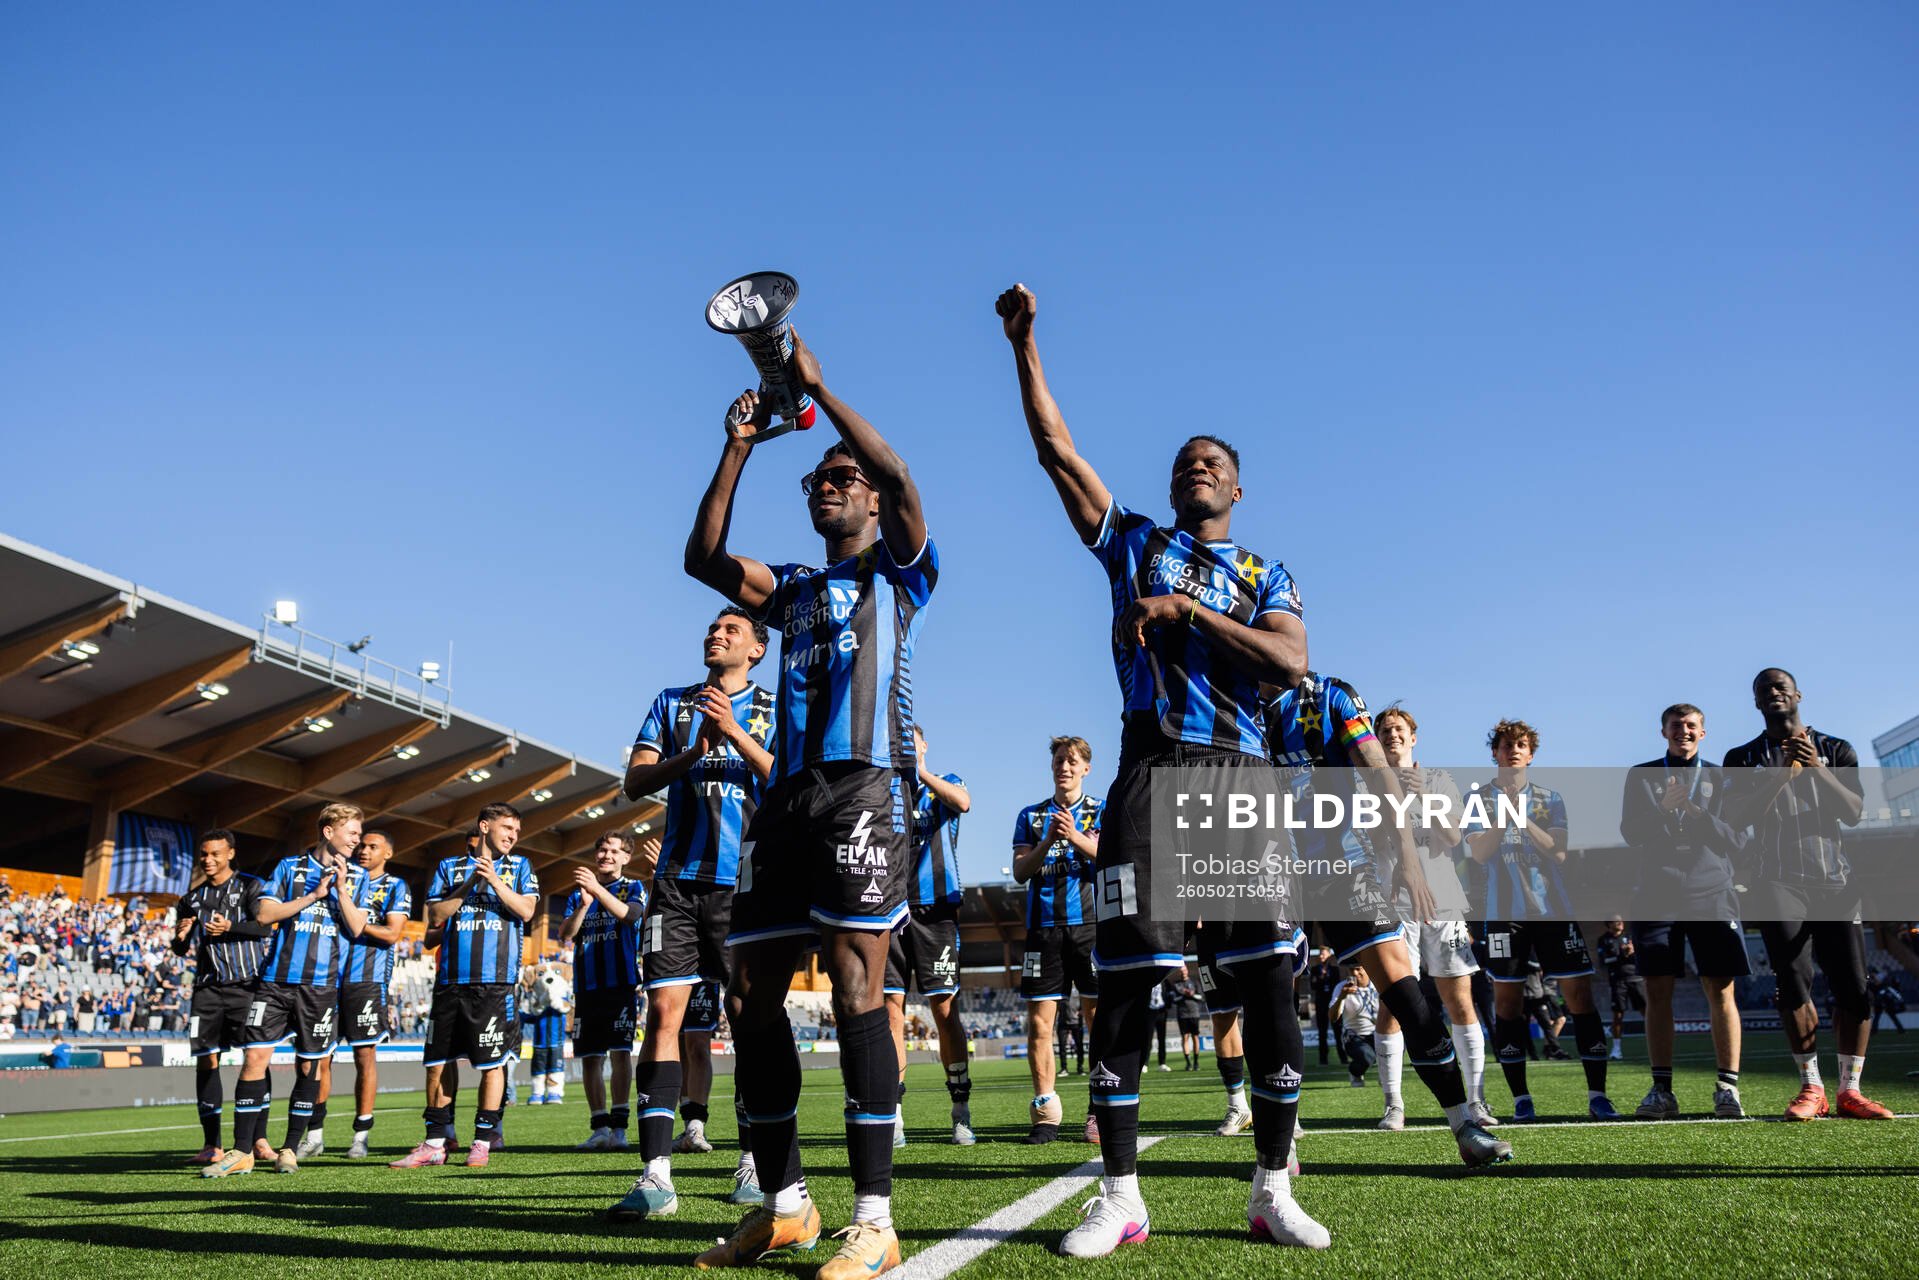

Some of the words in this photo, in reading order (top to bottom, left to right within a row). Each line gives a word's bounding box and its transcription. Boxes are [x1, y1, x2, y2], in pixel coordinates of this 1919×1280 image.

[1151, 553, 1194, 578] BYGG
[1147, 569, 1240, 614] CONSTRUCT
[784, 595, 820, 621] BYGG
[850, 866, 866, 875] TELE
[872, 868, 888, 877] DATA
[860, 894, 884, 904] SELECT
[294, 920, 338, 937] mirva
[456, 919, 503, 932] mirva
